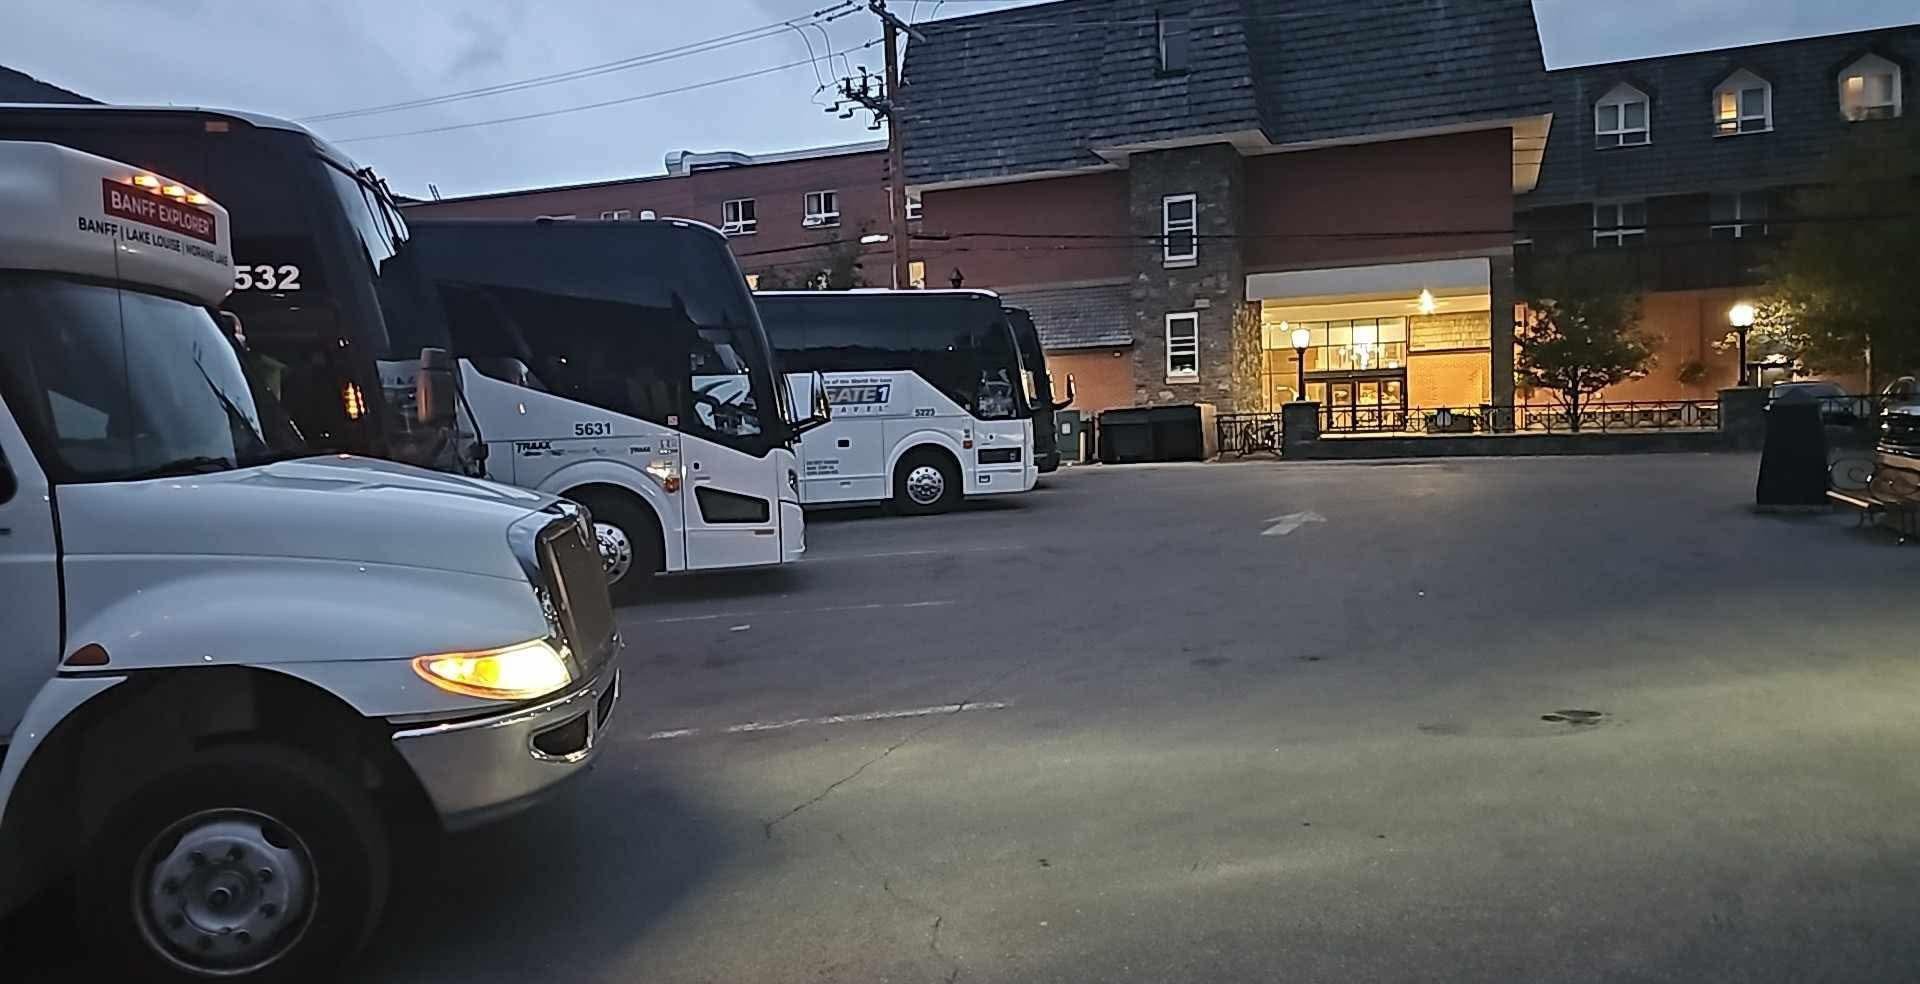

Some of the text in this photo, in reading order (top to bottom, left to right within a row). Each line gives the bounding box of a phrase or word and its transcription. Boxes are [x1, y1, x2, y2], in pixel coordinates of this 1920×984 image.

[111, 191, 209, 234] BANFF EXPLORER
[78, 216, 118, 236] BANFF
[126, 227, 151, 245] LAKE
[152, 234, 181, 252] LOUISE
[574, 422, 612, 436] 5631
